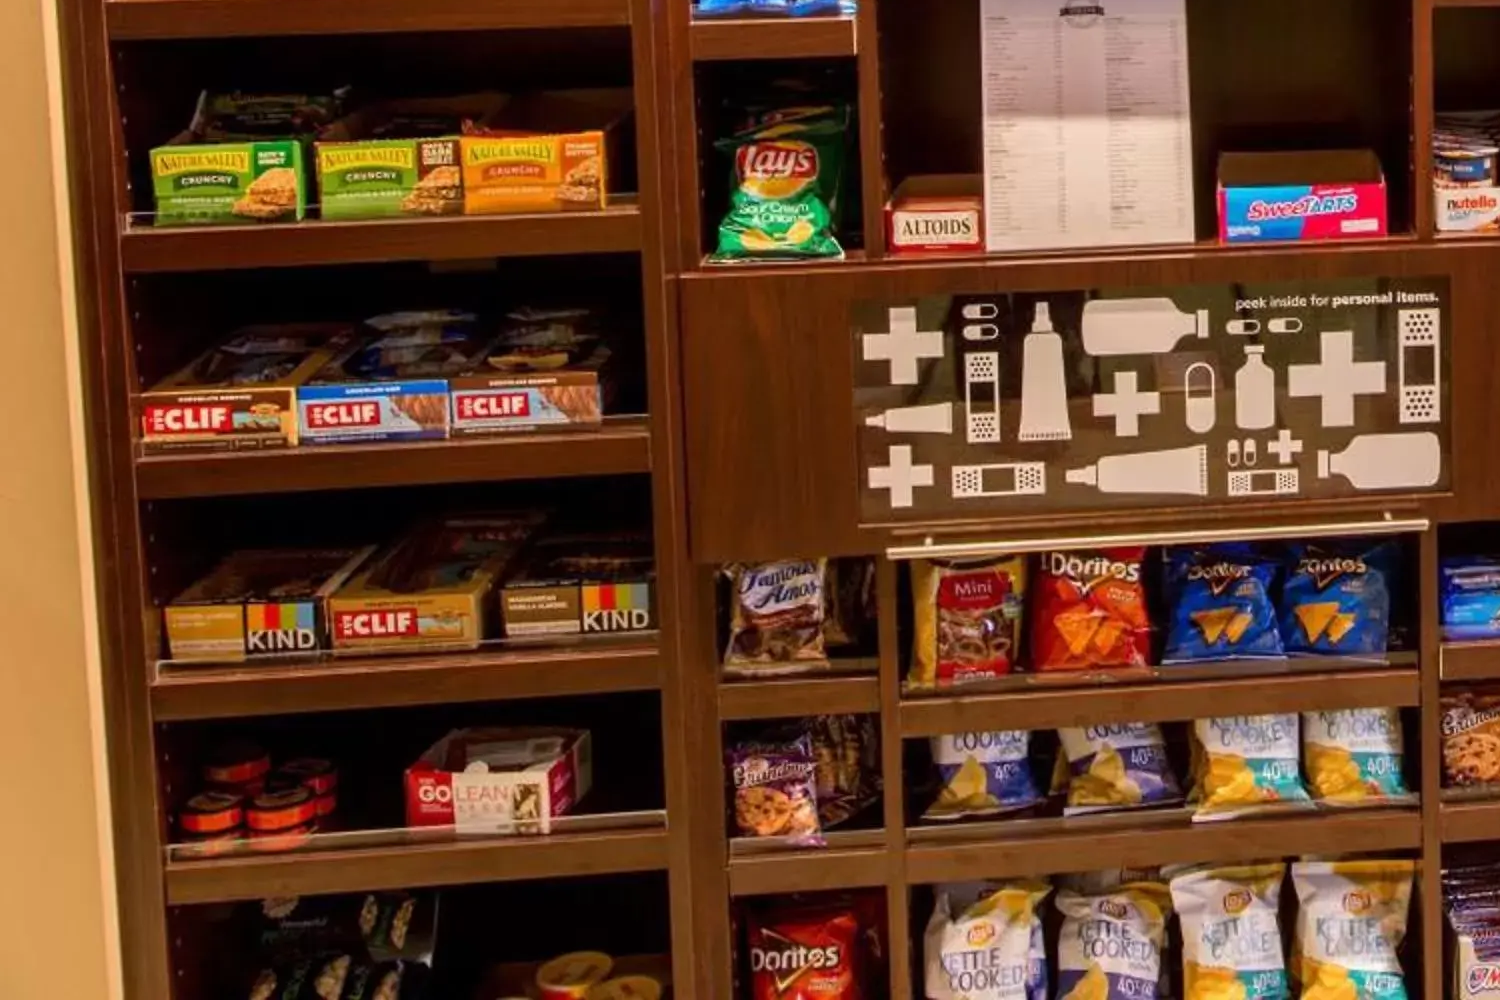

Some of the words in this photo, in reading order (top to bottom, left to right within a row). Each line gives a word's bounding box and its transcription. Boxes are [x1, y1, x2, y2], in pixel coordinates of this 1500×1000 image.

[181, 175, 233, 186] CRUNCHY
[345, 170, 398, 183] CRUNCHY
[488, 166, 541, 177] CRUNCHY
[1447, 195, 1498, 211] nutella
[902, 217, 972, 237] ALTOIDS
[1235, 298, 1267, 312] peek
[1269, 295, 1307, 308] inside
[1310, 293, 1329, 307] for
[1331, 292, 1393, 309] personal
[1396, 291, 1440, 304] items.
[322, 403, 377, 425] CLIF
[473, 395, 526, 416] CLIF
[165, 407, 228, 430] CLIF
[739, 561, 817, 594] Famous
[1050, 551, 1142, 582] Doritos
[754, 580, 819, 609] Amos
[954, 579, 994, 597] Mini
[354, 612, 413, 635] CLIF
[583, 609, 650, 632] KIND
[248, 629, 315, 651] KIND
[751, 944, 840, 973] Doritos
[950, 963, 1025, 993] COOKED
